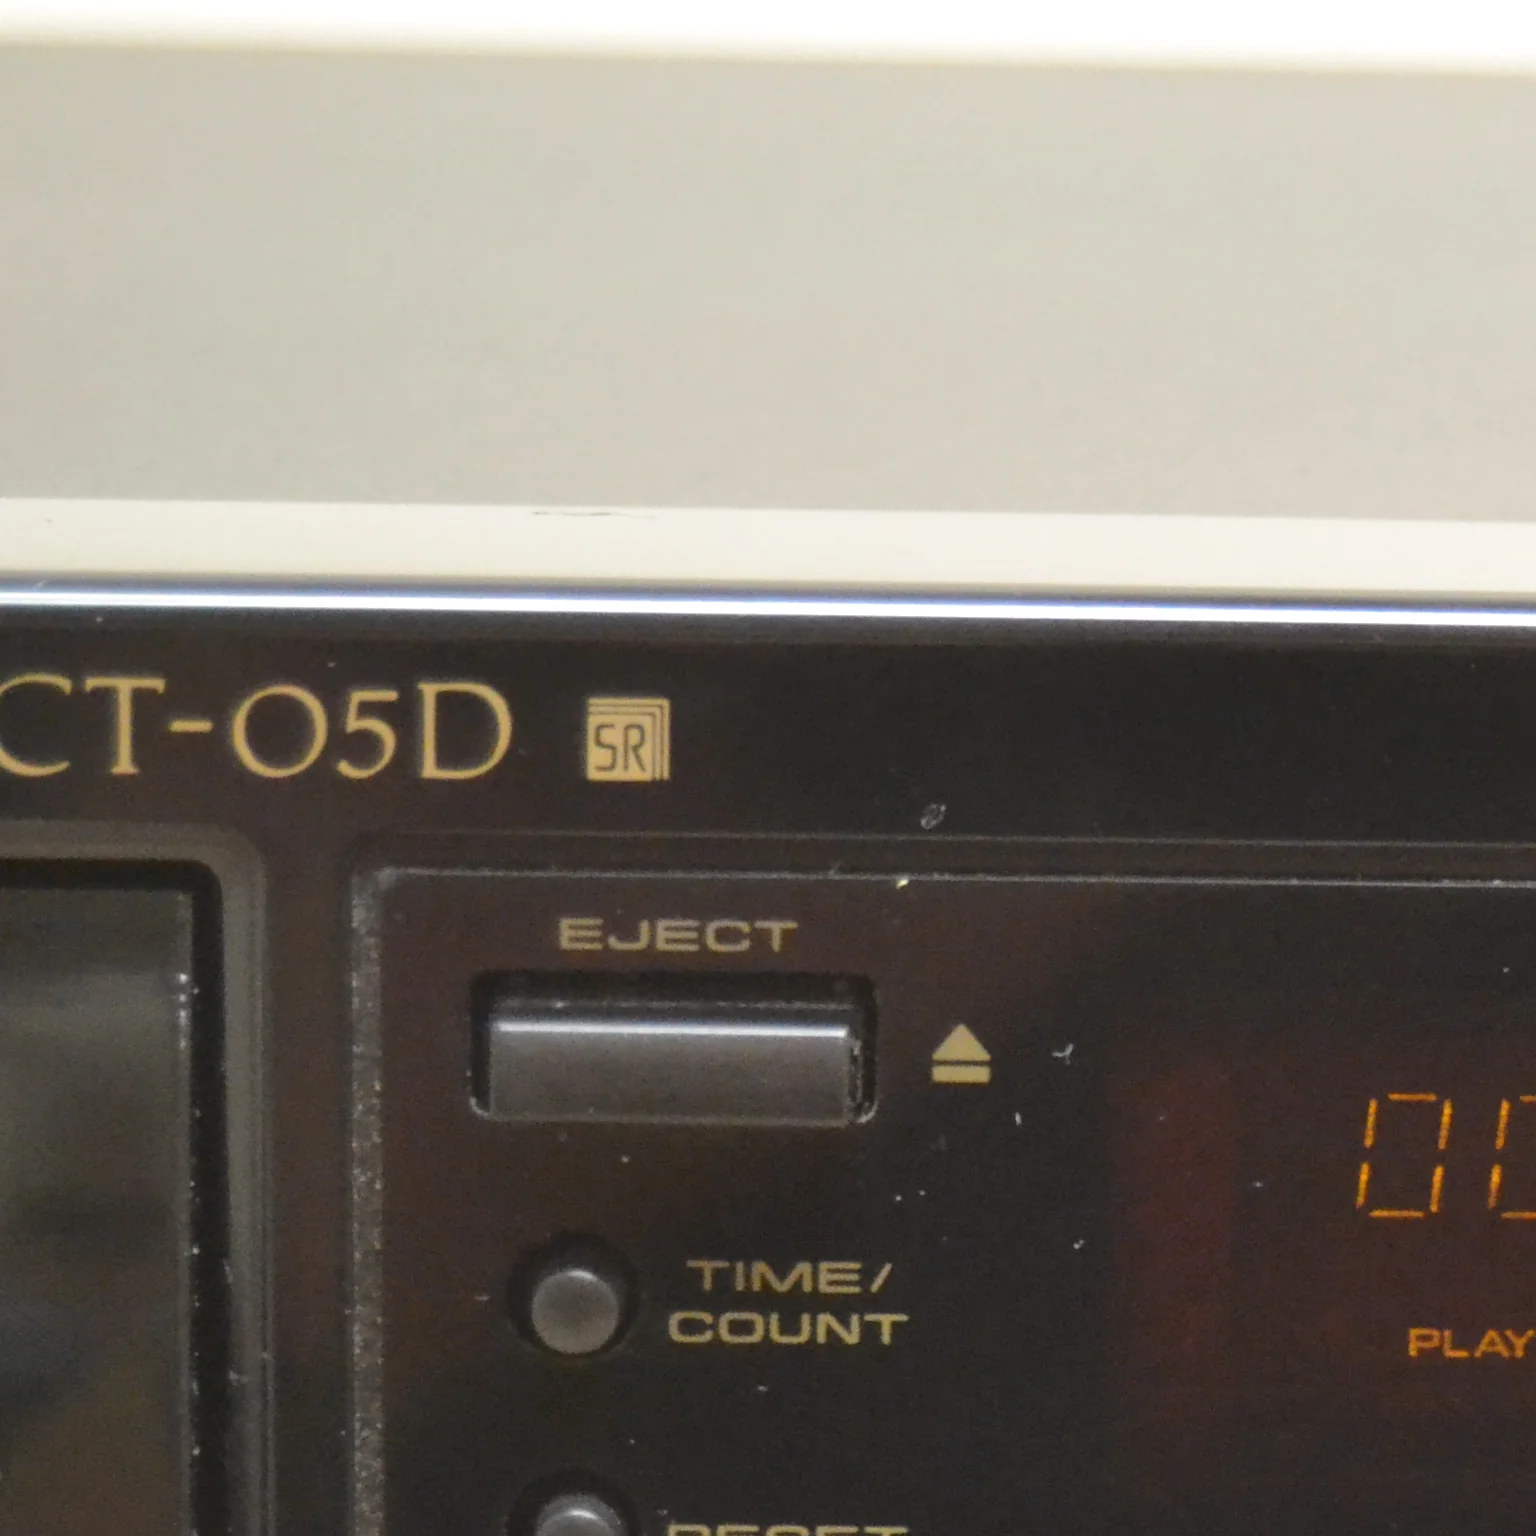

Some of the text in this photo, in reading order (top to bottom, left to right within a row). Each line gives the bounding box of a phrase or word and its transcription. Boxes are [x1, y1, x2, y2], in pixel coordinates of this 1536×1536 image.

[558, 916, 800, 953] EJECT
[686, 1259, 893, 1294] TIME/
[667, 1311, 910, 1345] COUNT
[1407, 1327, 1536, 1359] PLAY
